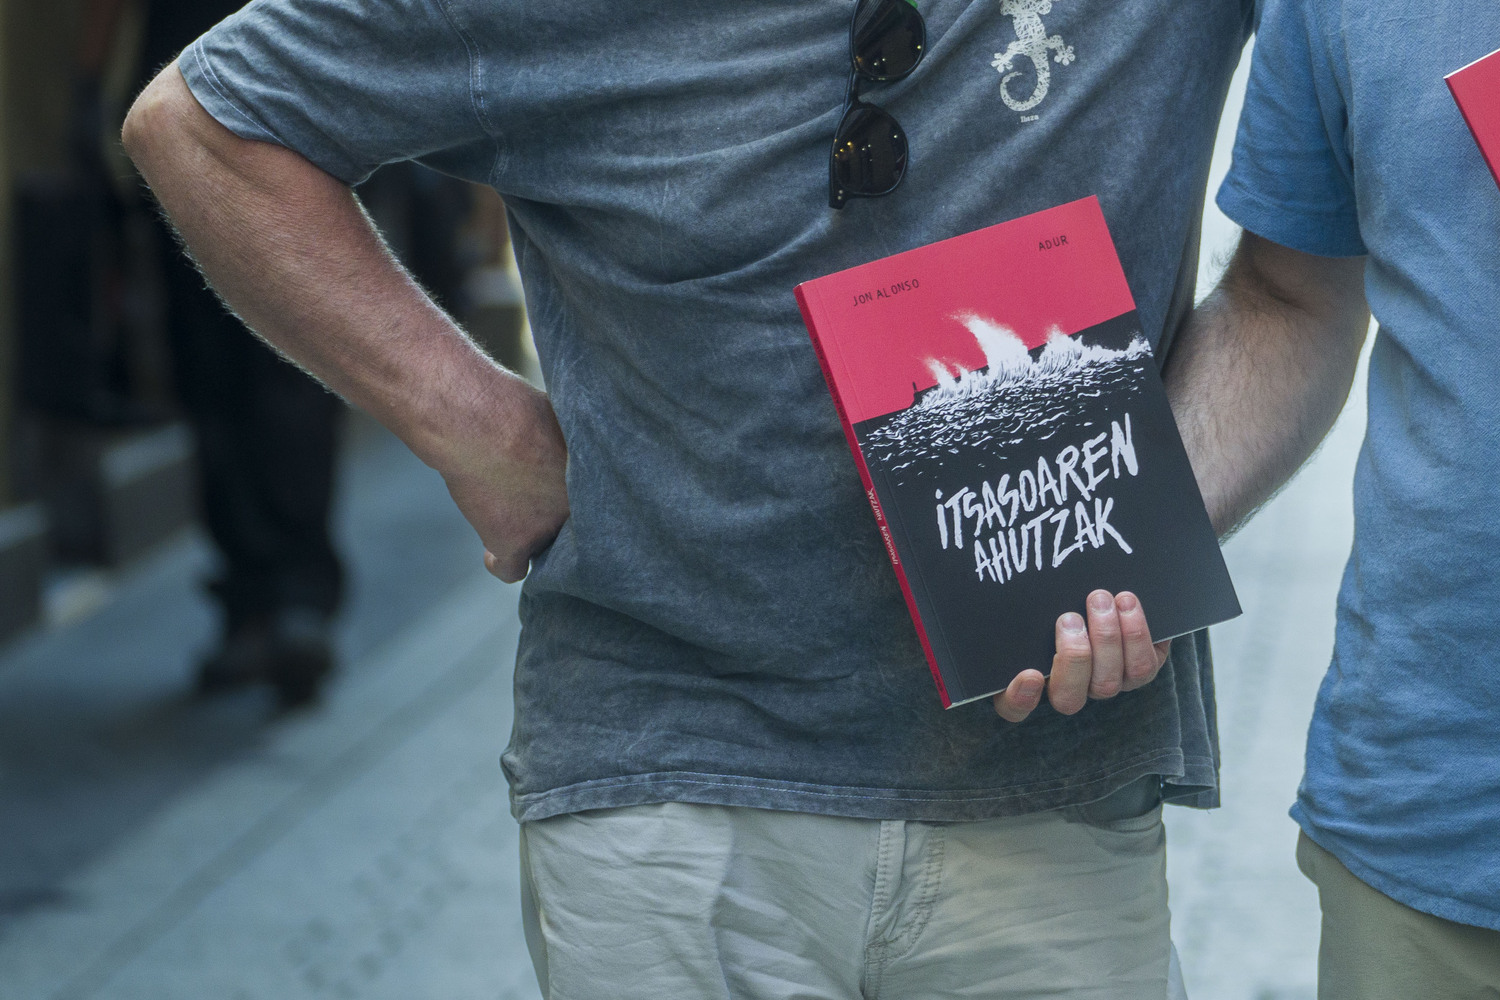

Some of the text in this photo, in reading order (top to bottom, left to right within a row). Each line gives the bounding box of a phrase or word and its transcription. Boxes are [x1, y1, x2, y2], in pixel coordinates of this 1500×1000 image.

[1039, 235, 1069, 252] ADUR
[853, 278, 920, 307] JON ALONSO
[974, 497, 1133, 584] AHUTZAK
